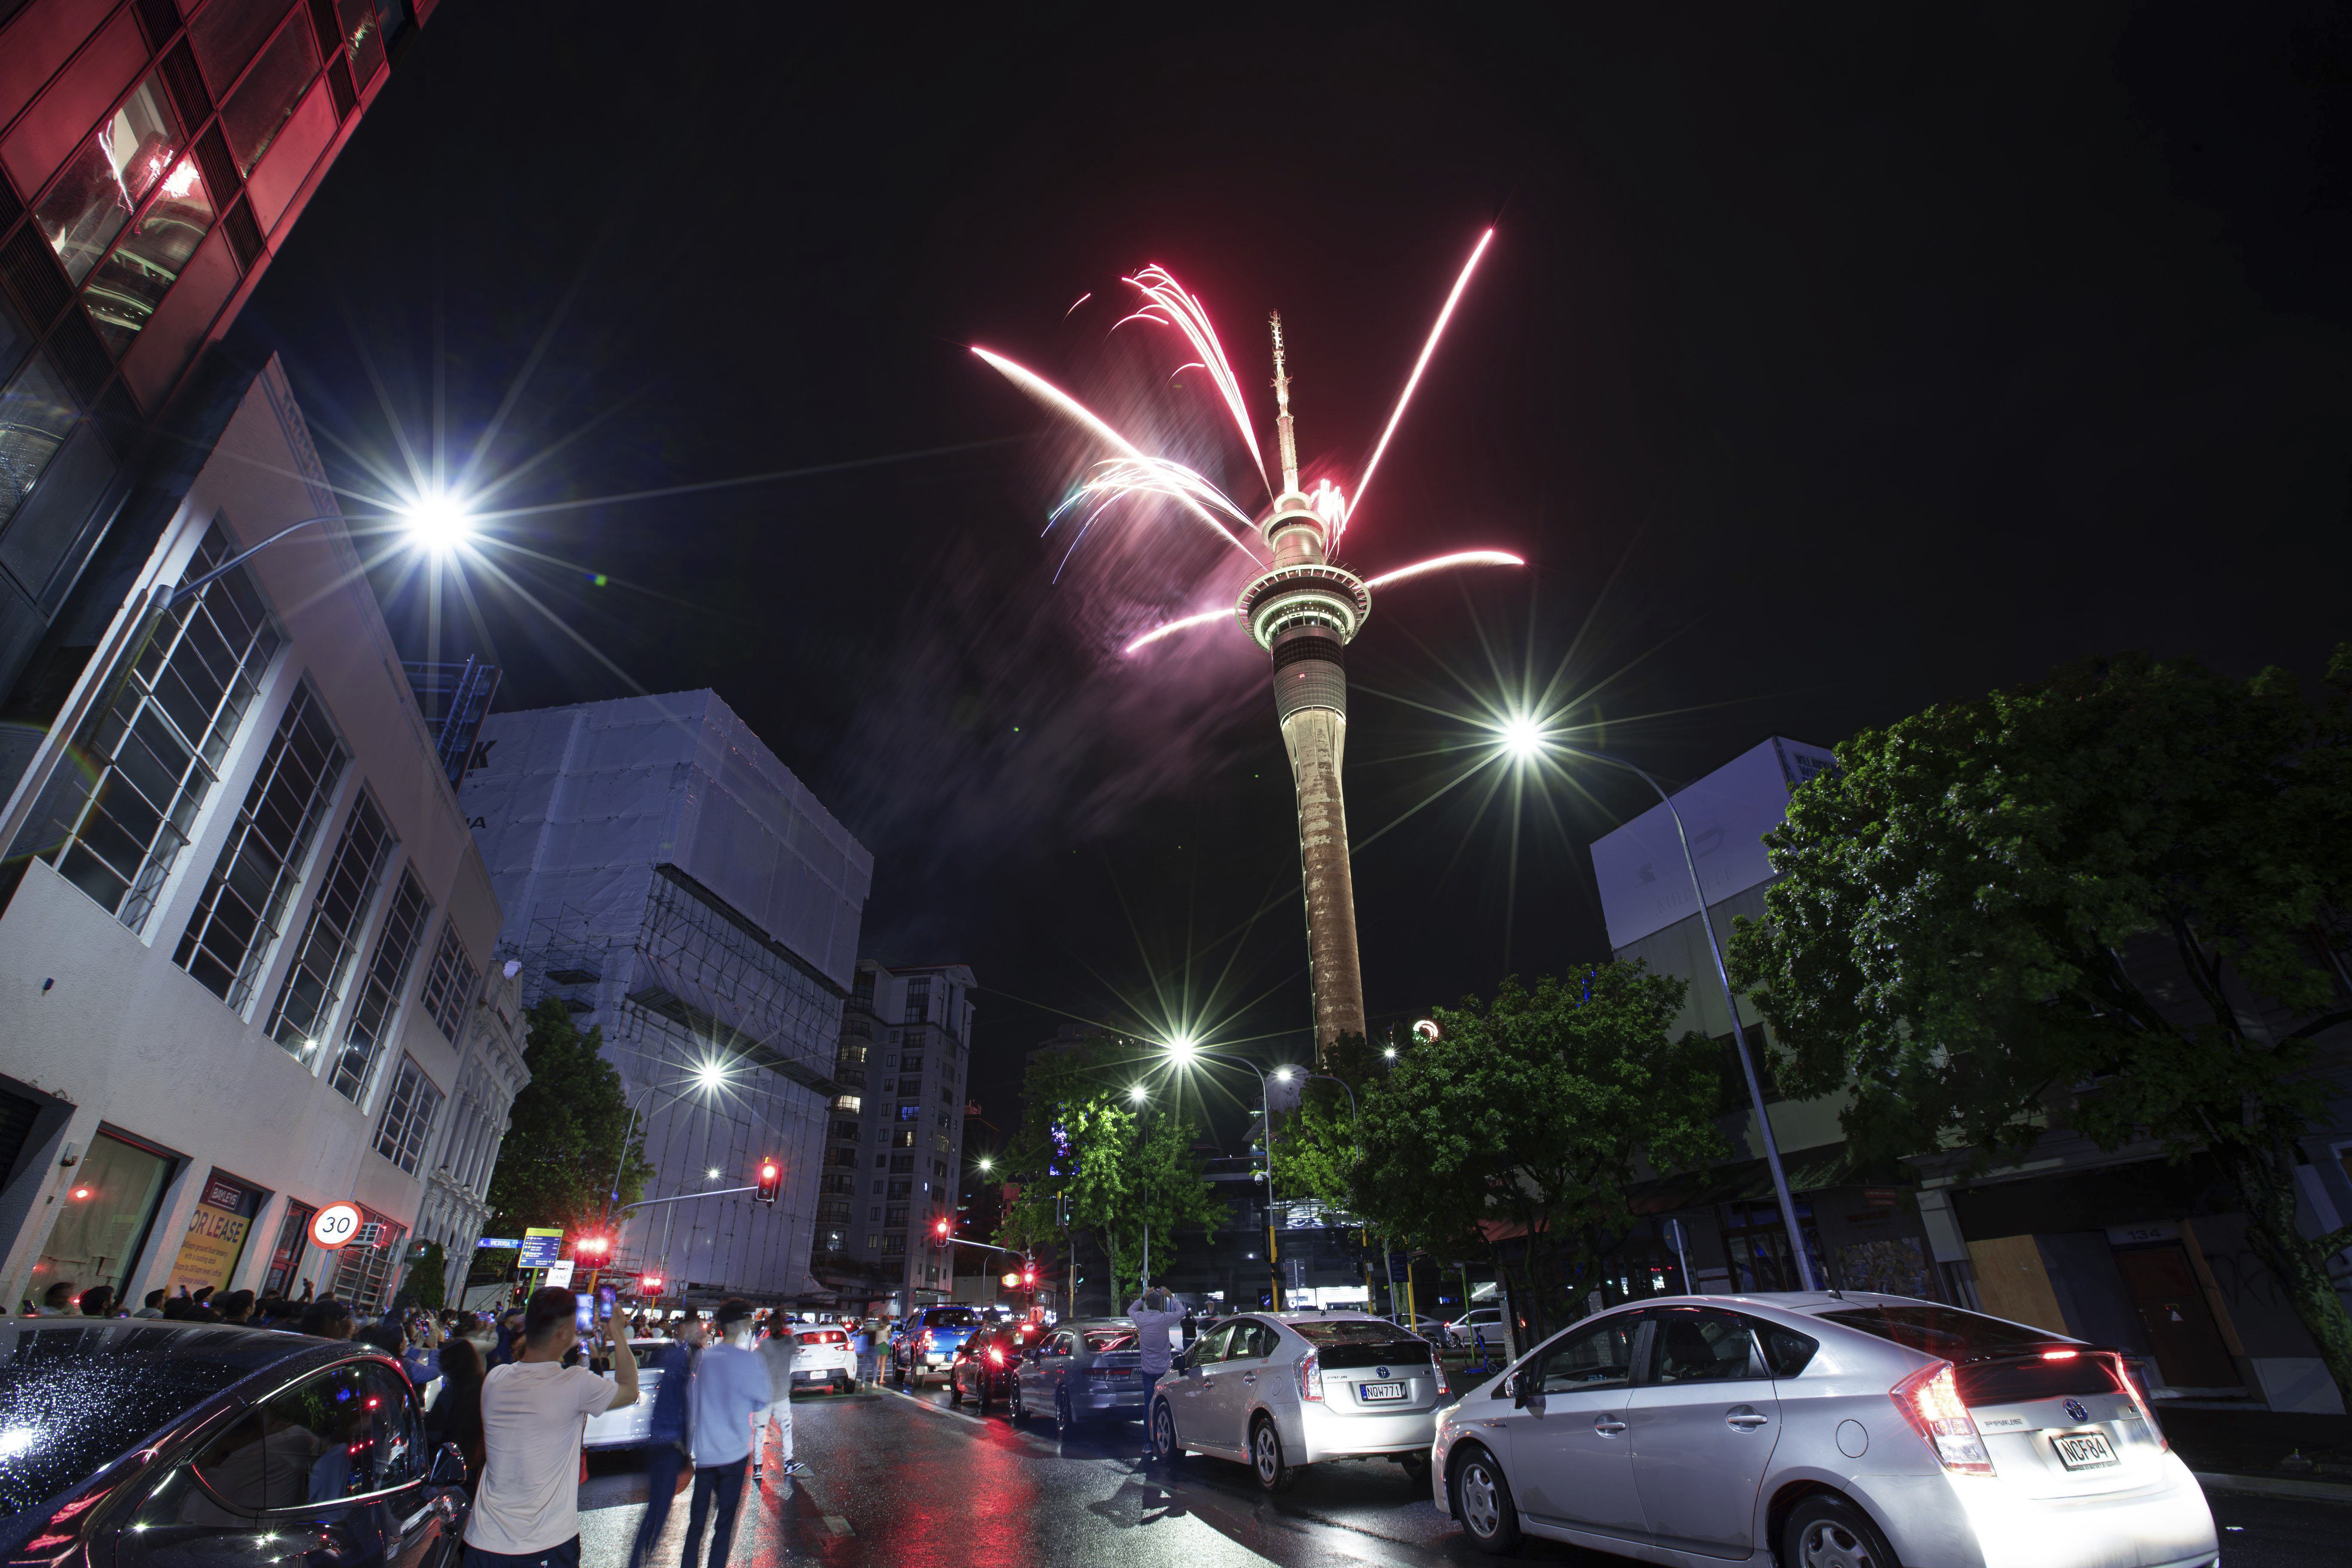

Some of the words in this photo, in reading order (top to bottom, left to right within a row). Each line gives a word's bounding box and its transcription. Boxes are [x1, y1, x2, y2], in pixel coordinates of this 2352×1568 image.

[211, 1188, 238, 1206] BAYLEYS
[189, 1210, 208, 1234] OR
[206, 1215, 243, 1243] LEASE
[323, 1217, 350, 1233] 30
[2127, 1228, 2161, 1240] 134
[1367, 1386, 1400, 1398] NQW771
[1984, 1418, 2023, 1427] PRIUS
[2061, 1438, 2108, 1462] NCF84
